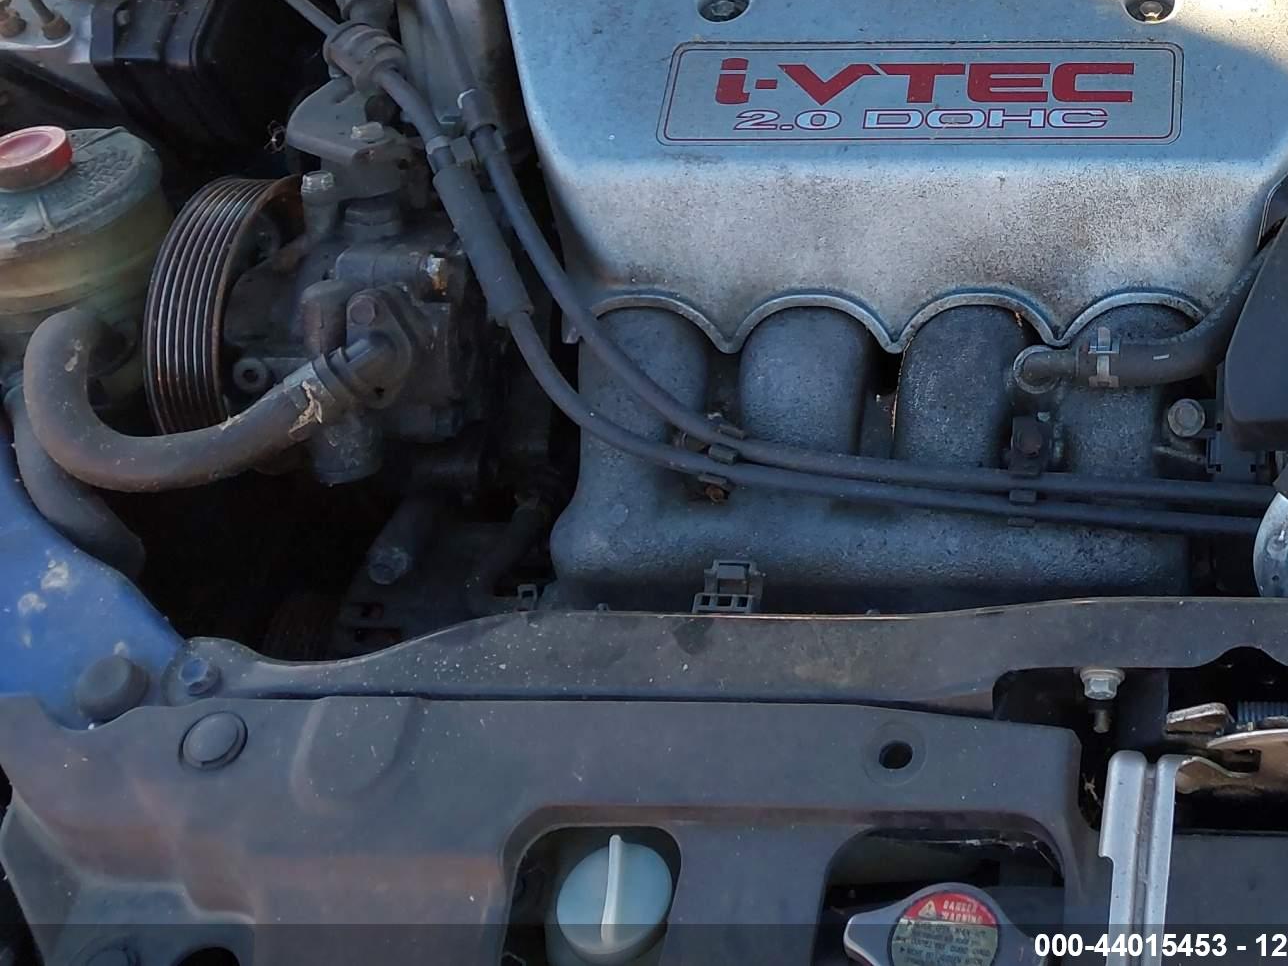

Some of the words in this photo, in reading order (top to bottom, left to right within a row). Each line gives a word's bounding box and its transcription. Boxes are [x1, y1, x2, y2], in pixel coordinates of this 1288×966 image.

[715, 57, 1134, 105] i-VTEC
[733, 109, 841, 130] 2.0
[862, 108, 1108, 130] DOHC
